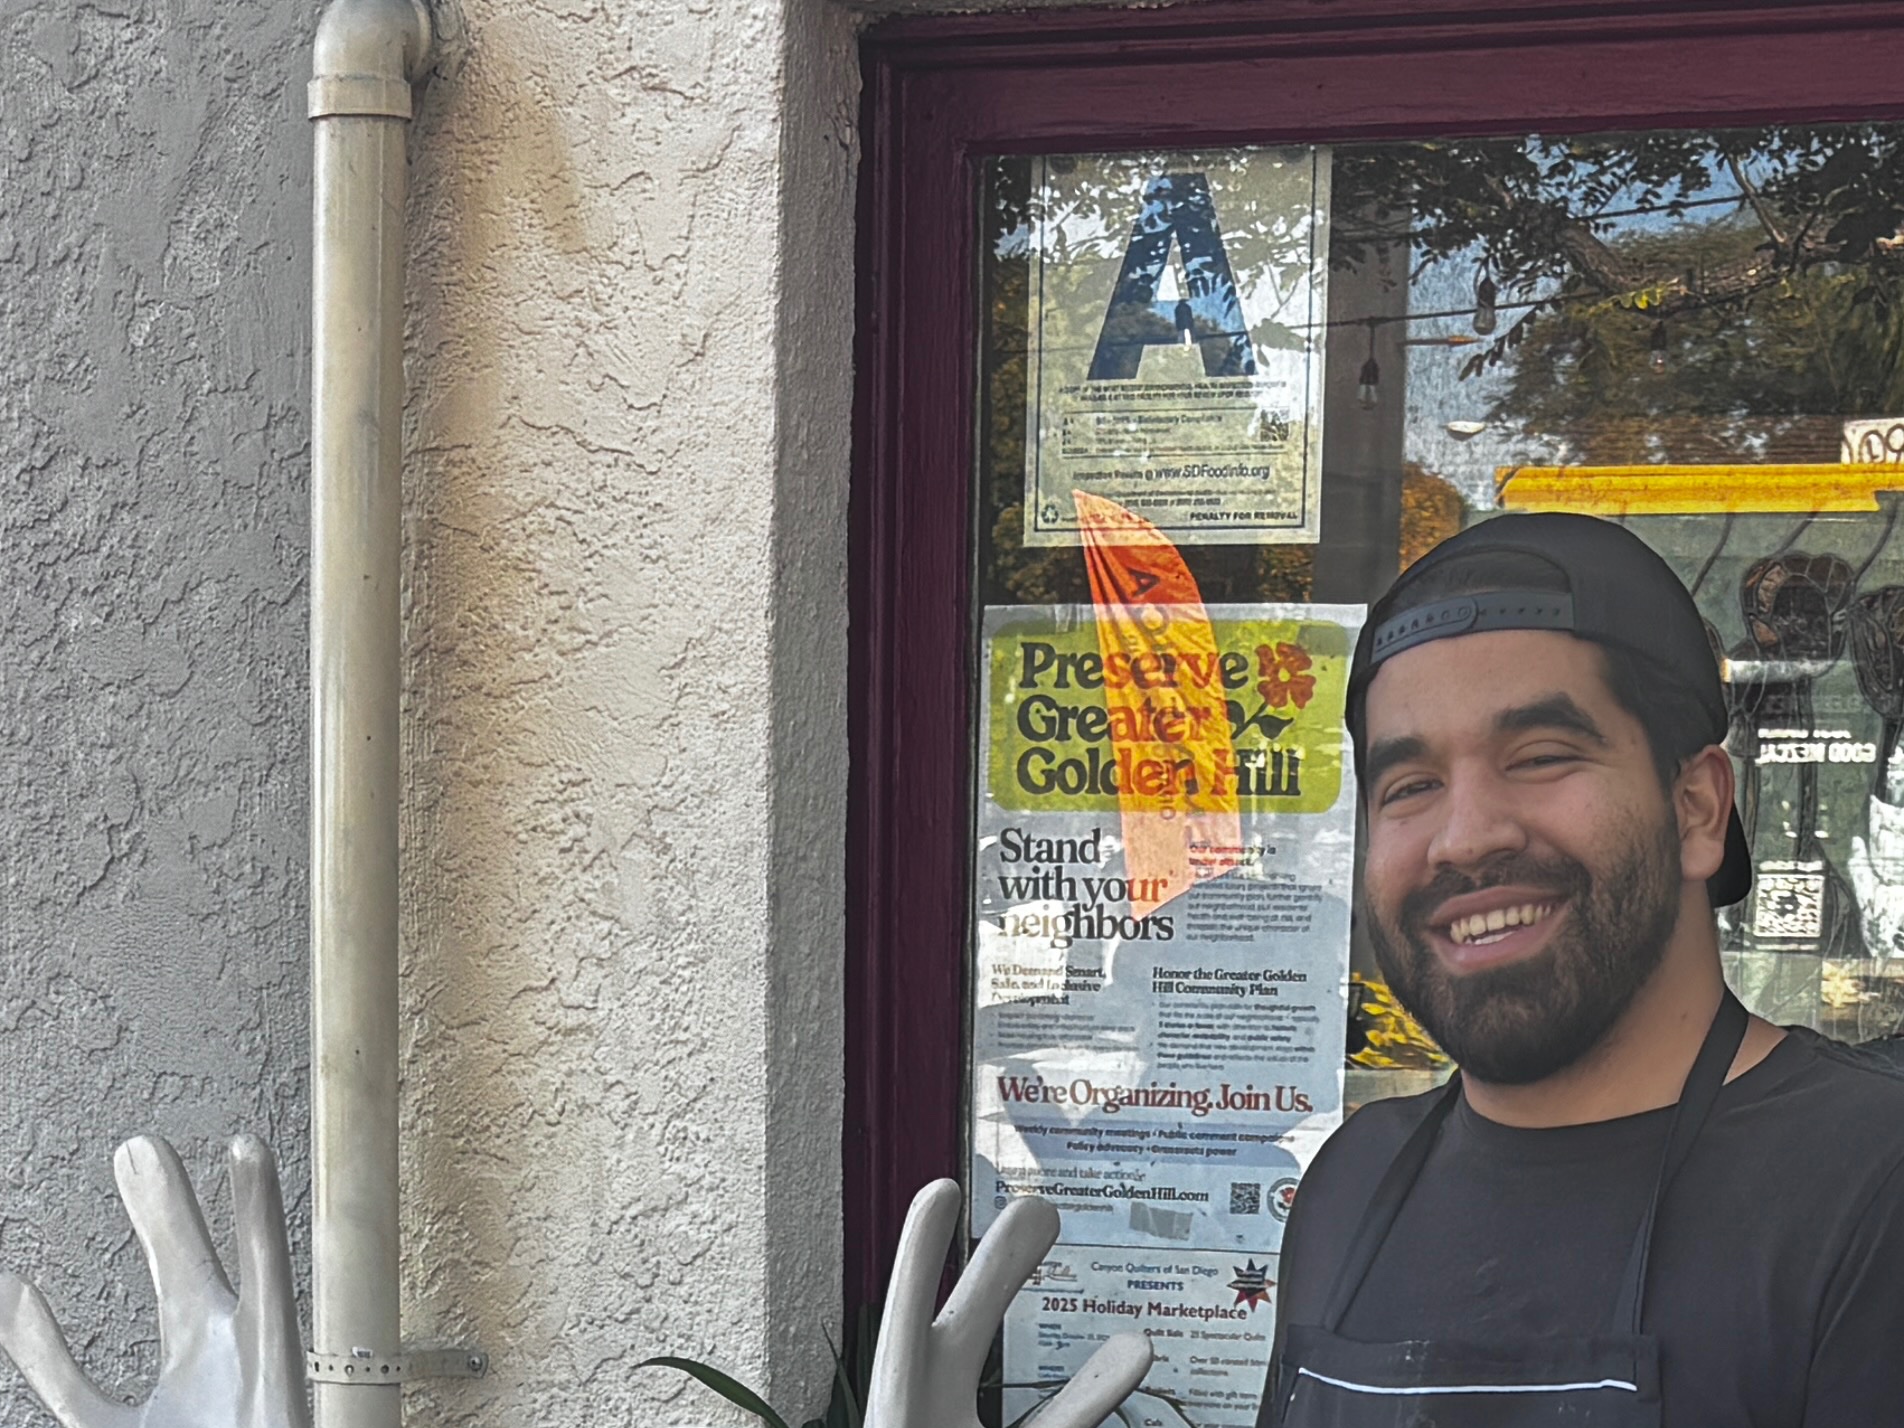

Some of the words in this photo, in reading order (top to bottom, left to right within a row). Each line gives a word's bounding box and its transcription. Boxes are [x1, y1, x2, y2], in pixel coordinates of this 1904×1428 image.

[1086, 172, 1257, 380] A
[1017, 641, 1249, 690] Preserve
[1016, 693, 1211, 743] Greater
[1016, 746, 1199, 796] Golden
[1209, 747, 1302, 796] Hill
[1000, 828, 1101, 863] Stand
[998, 866, 1077, 900] with
[1082, 876, 1168, 911] your
[998, 903, 1174, 948] neighbors
[1214, 967, 1262, 982] Greater
[1262, 968, 1307, 982] Golden
[997, 1076, 1067, 1102] We're
[1069, 1079, 1213, 1116] Organizing.
[1215, 1083, 1272, 1112] Join
[1274, 1086, 1313, 1113] Us.
[1127, 1280, 1184, 1291] PRESENTS
[1042, 1297, 1078, 1312] 2025
[1083, 1300, 1143, 1318] Holiday
[1147, 1302, 1247, 1322] Marketplace
